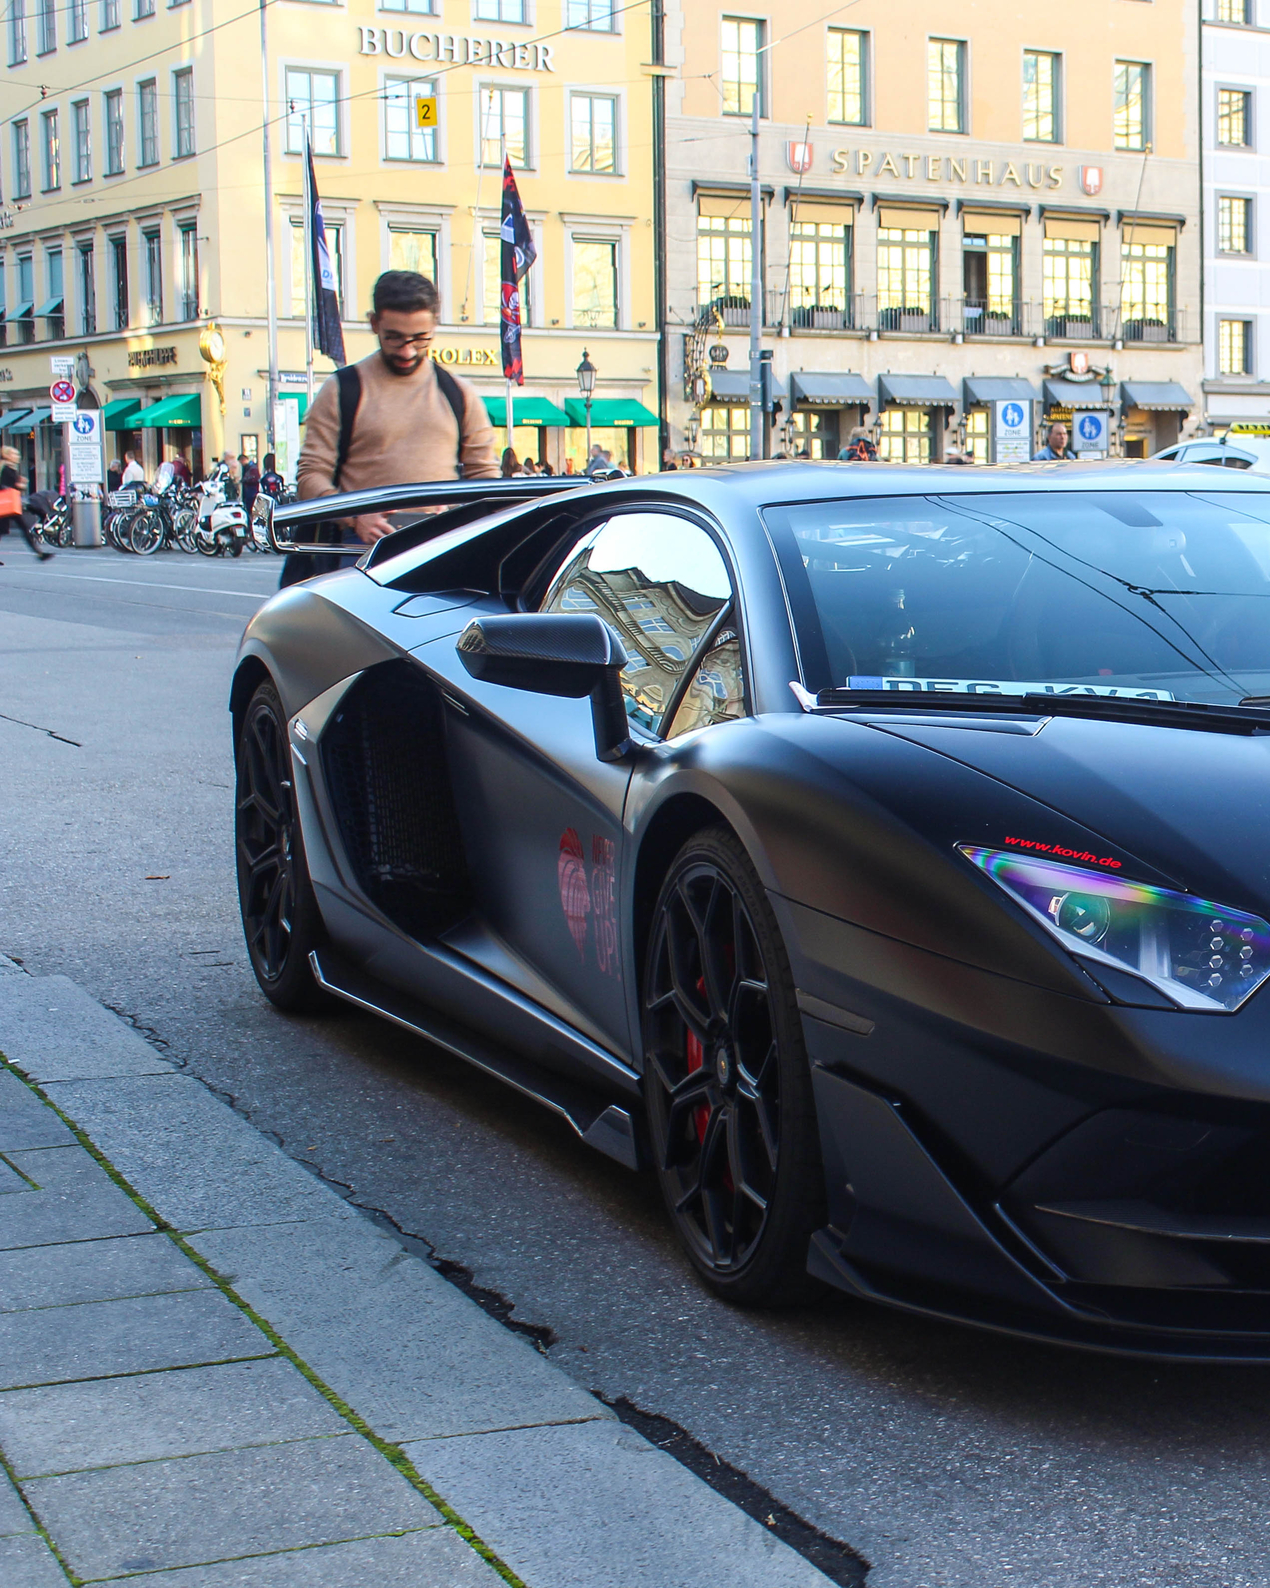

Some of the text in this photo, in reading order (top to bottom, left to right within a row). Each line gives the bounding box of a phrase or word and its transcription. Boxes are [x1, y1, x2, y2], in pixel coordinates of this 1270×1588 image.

[357, 26, 556, 73] BUCHERER
[421, 104, 431, 120] 2
[832, 149, 1063, 188] SPATENHAUS
[428, 347, 499, 365] ROLEX
[1005, 837, 1122, 868] www.kovin.de
